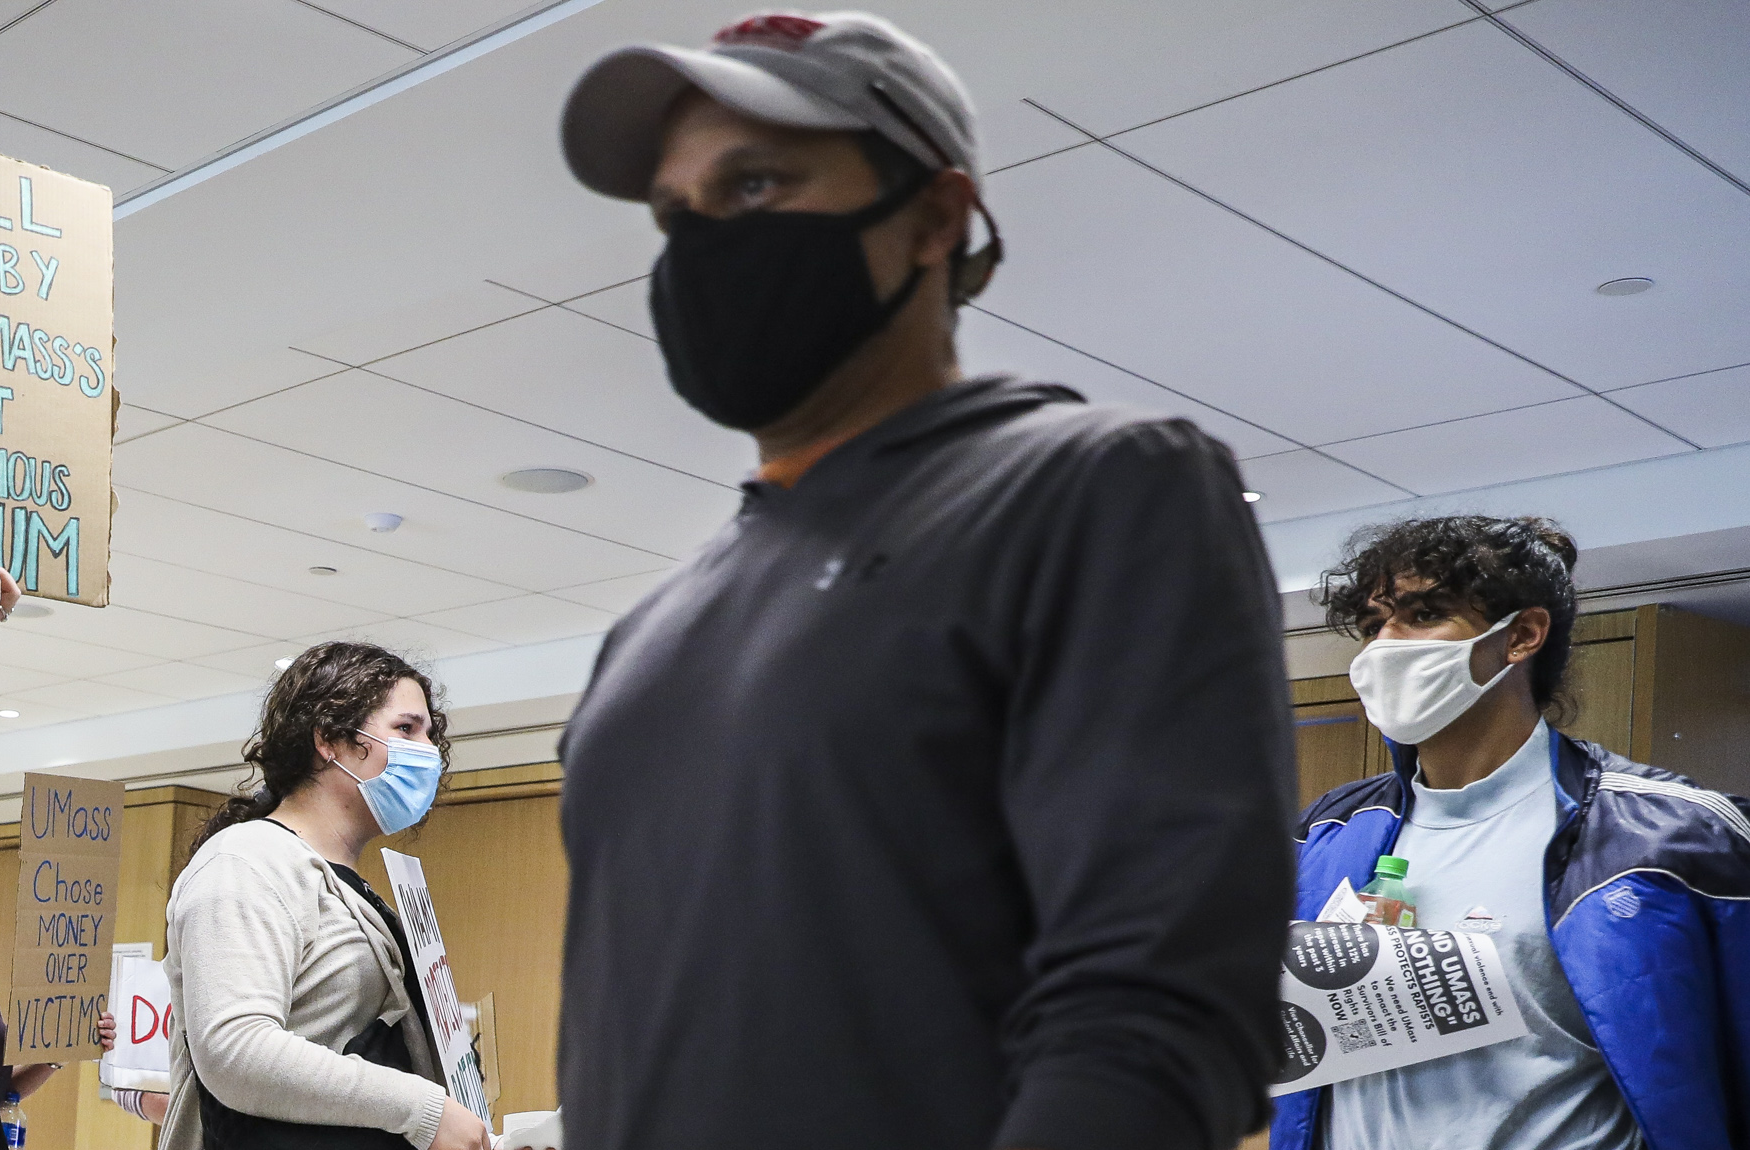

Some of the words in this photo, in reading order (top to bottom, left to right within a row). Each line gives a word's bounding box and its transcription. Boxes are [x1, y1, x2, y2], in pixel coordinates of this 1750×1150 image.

[30, 786, 112, 841] UMass
[33, 860, 103, 905] Chose
[37, 914, 103, 948] MONEY
[1292, 945, 1308, 968] years
[1306, 947, 1321, 966] past
[1321, 947, 1336, 974] within
[1348, 947, 1361, 964] 12%
[1359, 941, 1370, 957] has
[45, 953, 88, 985] OVER
[1392, 937, 1418, 990] PROTECTS
[1410, 992, 1435, 1030] RAPISTS
[1426, 929, 1454, 953] ND
[1441, 956, 1481, 1023] UMASS
[1327, 992, 1348, 1021] NOW
[1343, 988, 1359, 1016] Rights
[1357, 985, 1377, 1023] Survivors
[1374, 1022, 1387, 1037] Bill
[1381, 1037, 1393, 1047] of
[1370, 980, 1378, 991] to
[1375, 992, 1392, 1016] enact
[1386, 1014, 1397, 1032] the
[1384, 976, 1395, 992] We
[1391, 992, 1406, 1014] need
[1402, 1014, 1418, 1043] UMass
[17, 993, 106, 1052] VICTIMS
